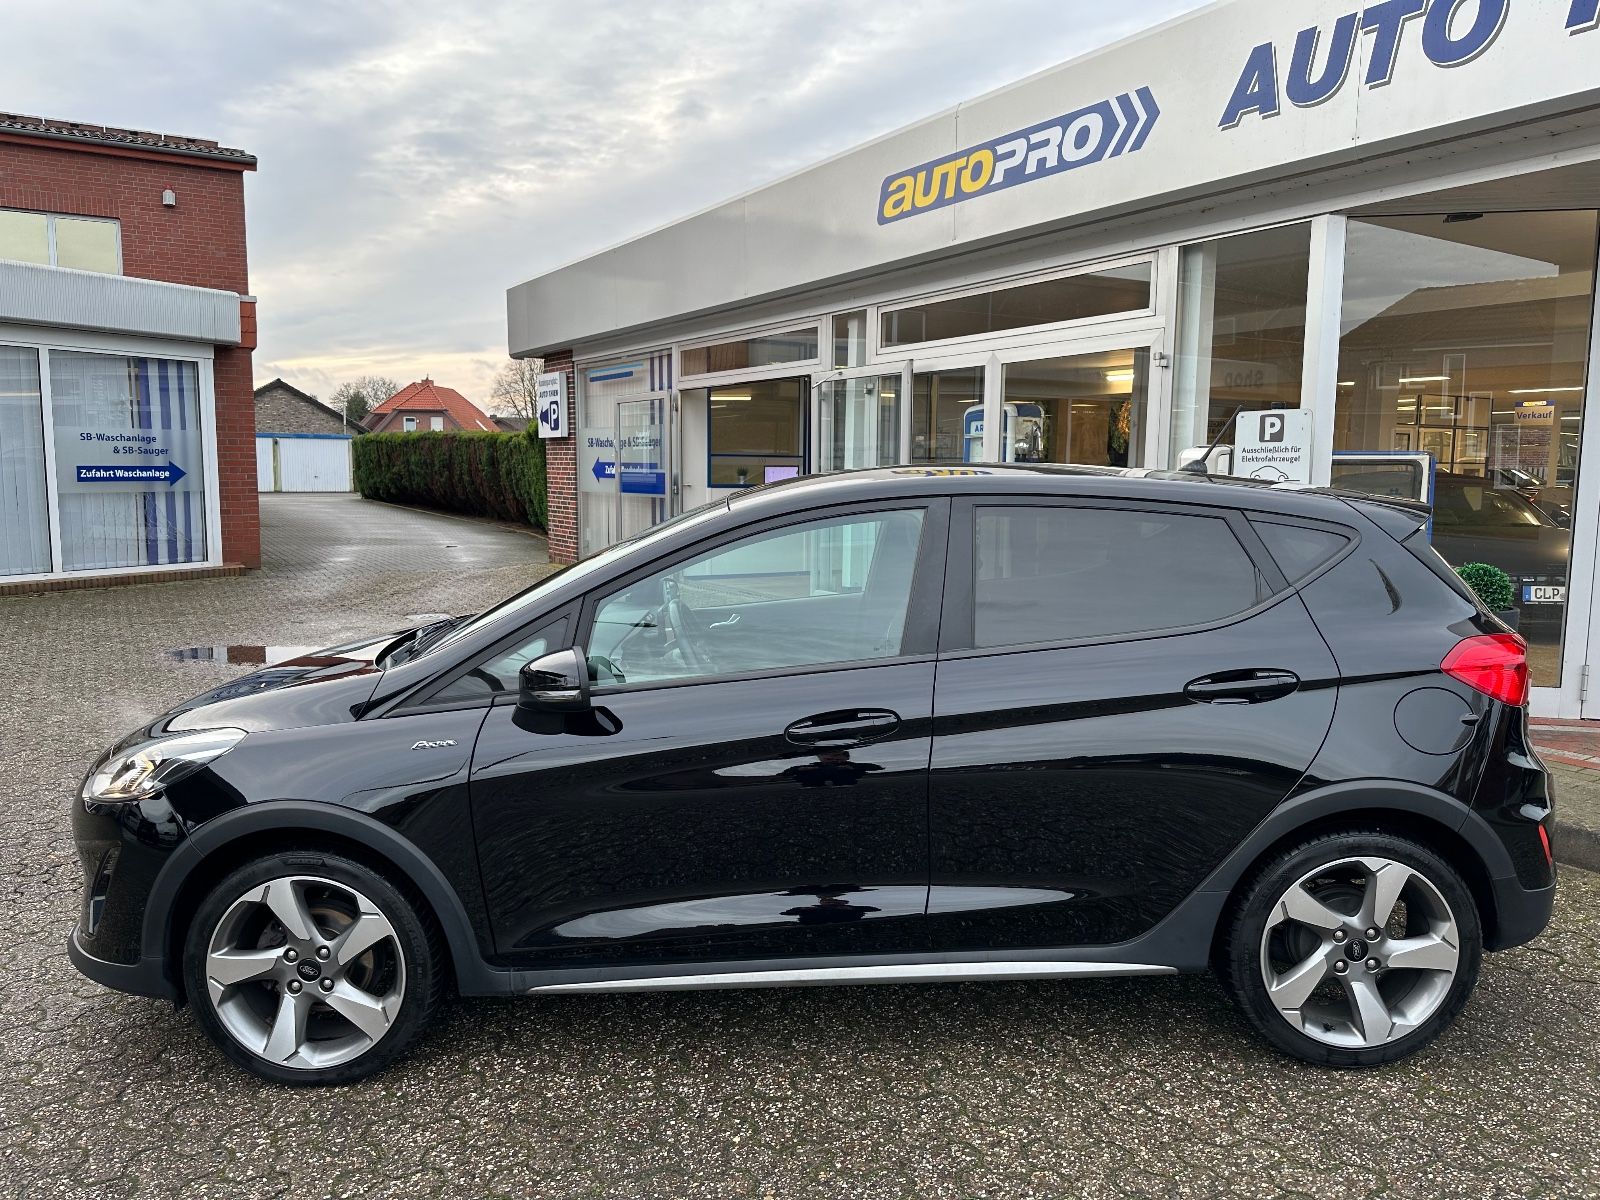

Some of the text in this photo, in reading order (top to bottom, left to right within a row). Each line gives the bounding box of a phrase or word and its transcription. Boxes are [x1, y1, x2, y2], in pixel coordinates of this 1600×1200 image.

[1218, 0, 1510, 131] AUTO
[551, 403, 558, 428] P
[1516, 410, 1553, 419] Verkauf
[974, 424, 984, 432] AR
[1264, 416, 1282, 441] P
[80, 433, 157, 444] SB-Waschanlage
[113, 446, 169, 456] & SB-Sauger
[1241, 446, 1290, 455] Ausschließlich
[1241, 456, 1301, 464] Elektrofahrzeuge!
[80, 469, 170, 479] Zufahrt Waschanlage
[1534, 587, 1560, 600] CLP
